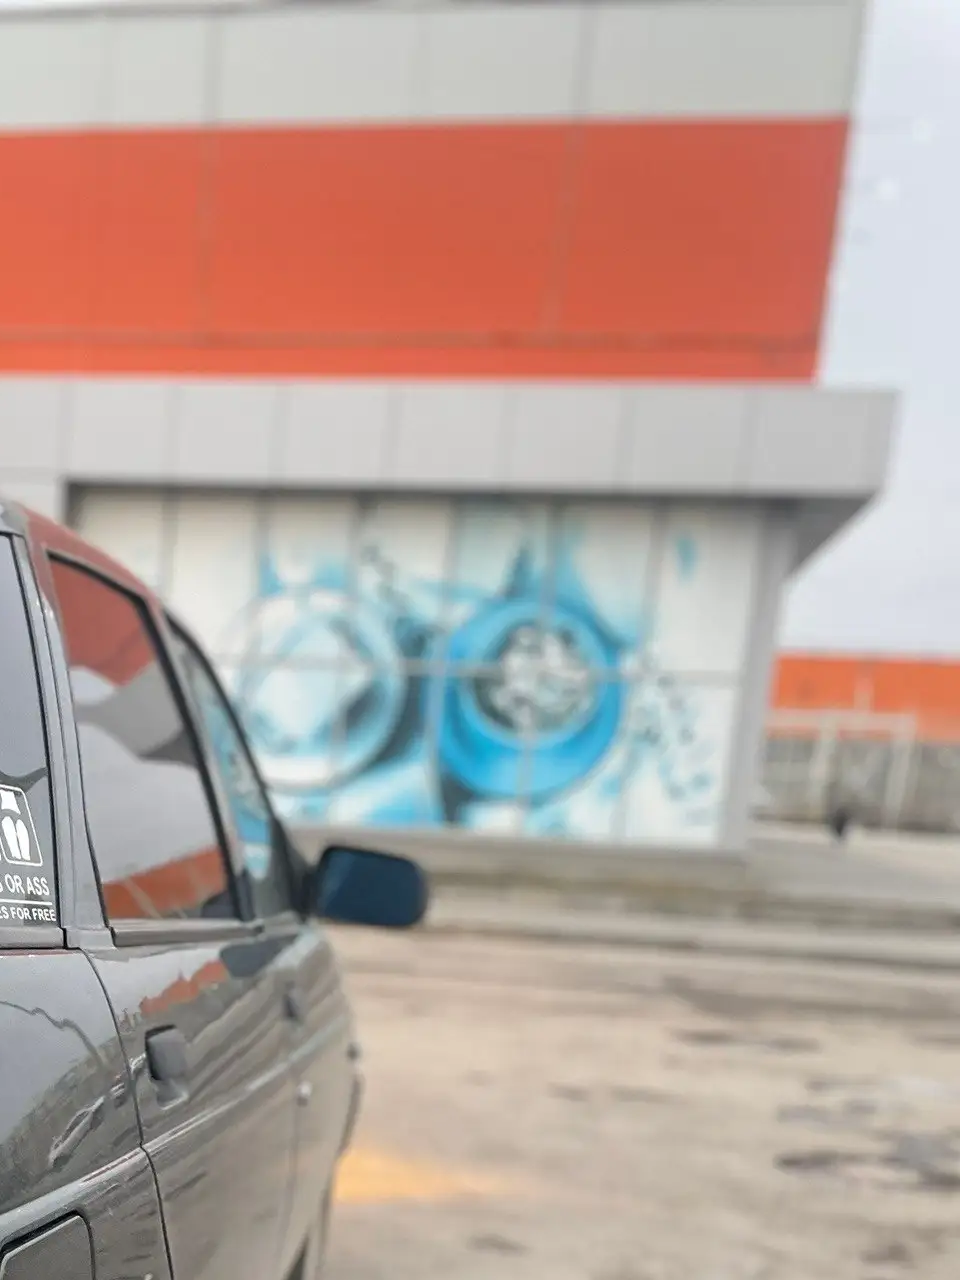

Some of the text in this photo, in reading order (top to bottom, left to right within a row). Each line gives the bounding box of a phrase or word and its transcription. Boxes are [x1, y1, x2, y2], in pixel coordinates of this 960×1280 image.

[4, 873, 25, 894] OR
[27, 876, 50, 896] ASS
[11, 907, 33, 921] FOR
[33, 909, 57, 922] FREE
